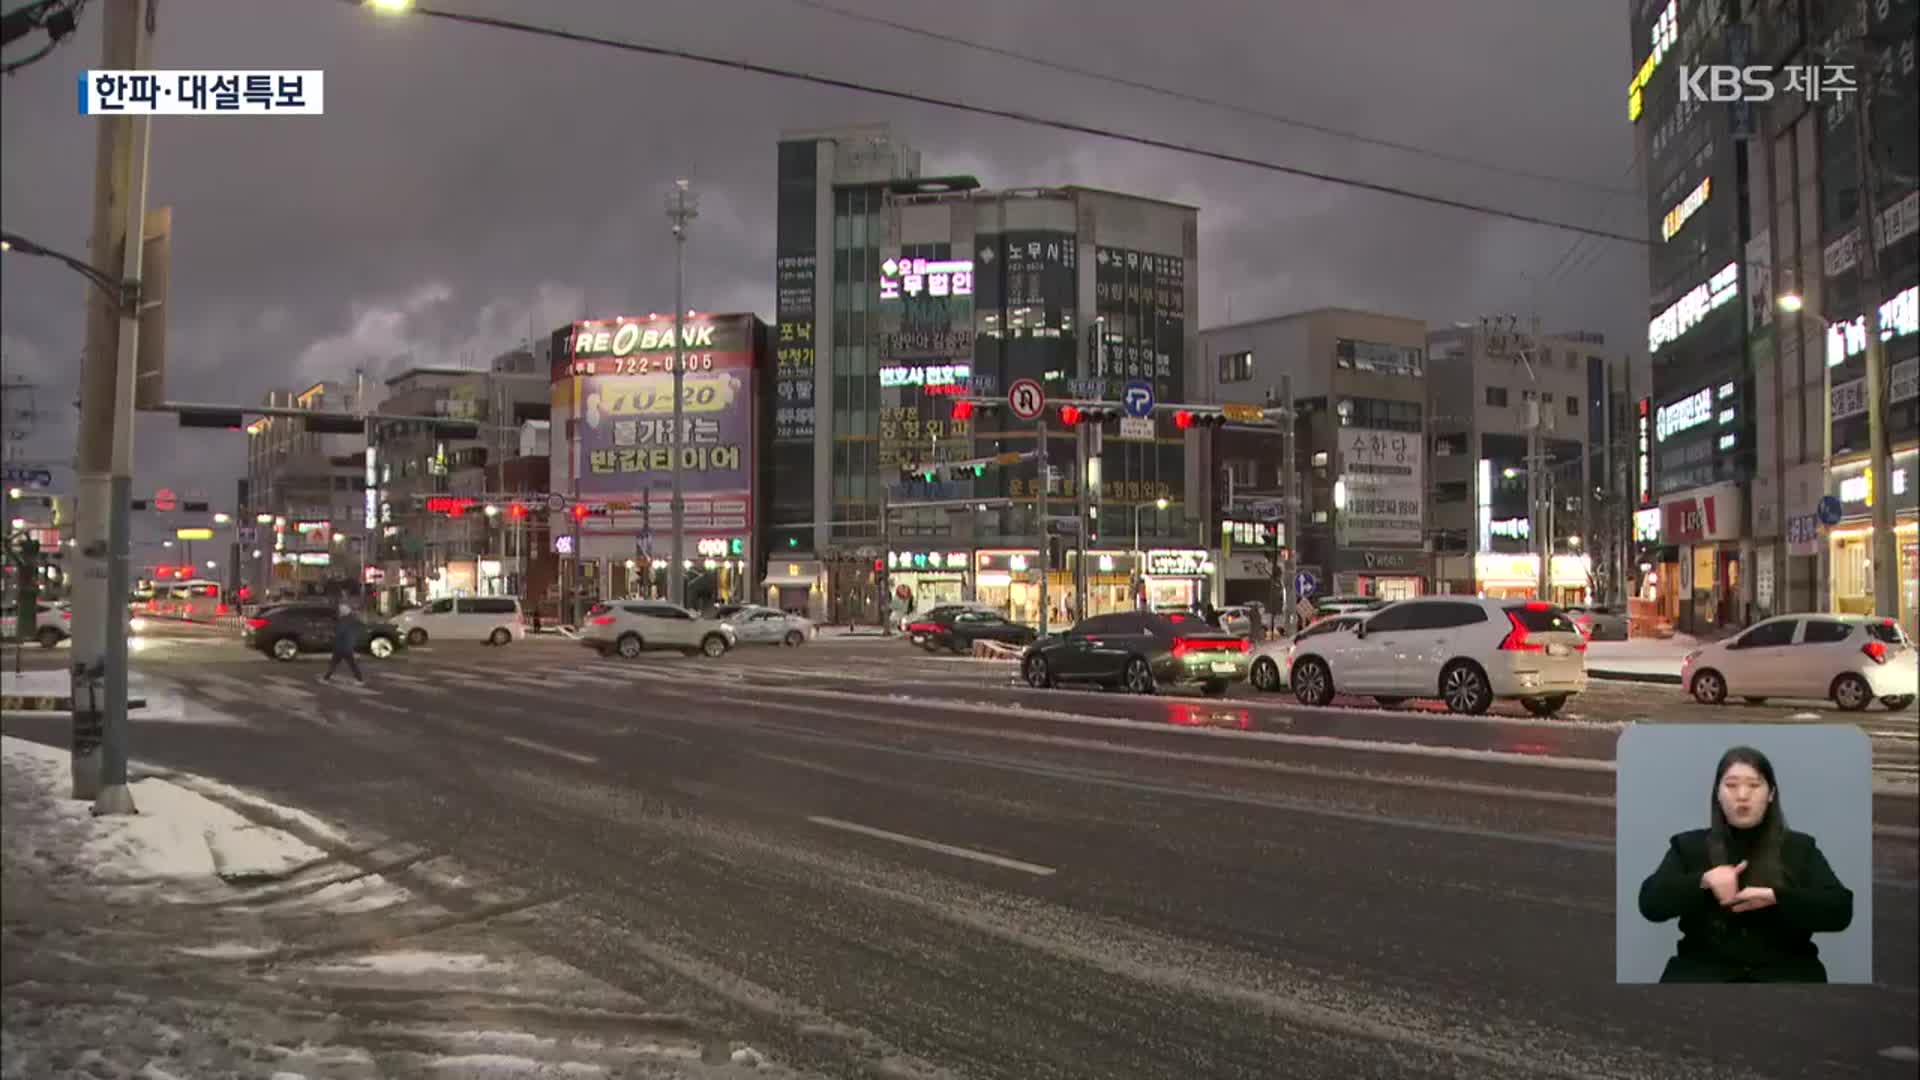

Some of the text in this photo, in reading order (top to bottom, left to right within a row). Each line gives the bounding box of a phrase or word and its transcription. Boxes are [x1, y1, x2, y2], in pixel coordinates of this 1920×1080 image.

[1009, 243, 1058, 262] 노무사
[879, 272, 973, 299] 노무법인
[590, 446, 740, 473] 반값타이어
